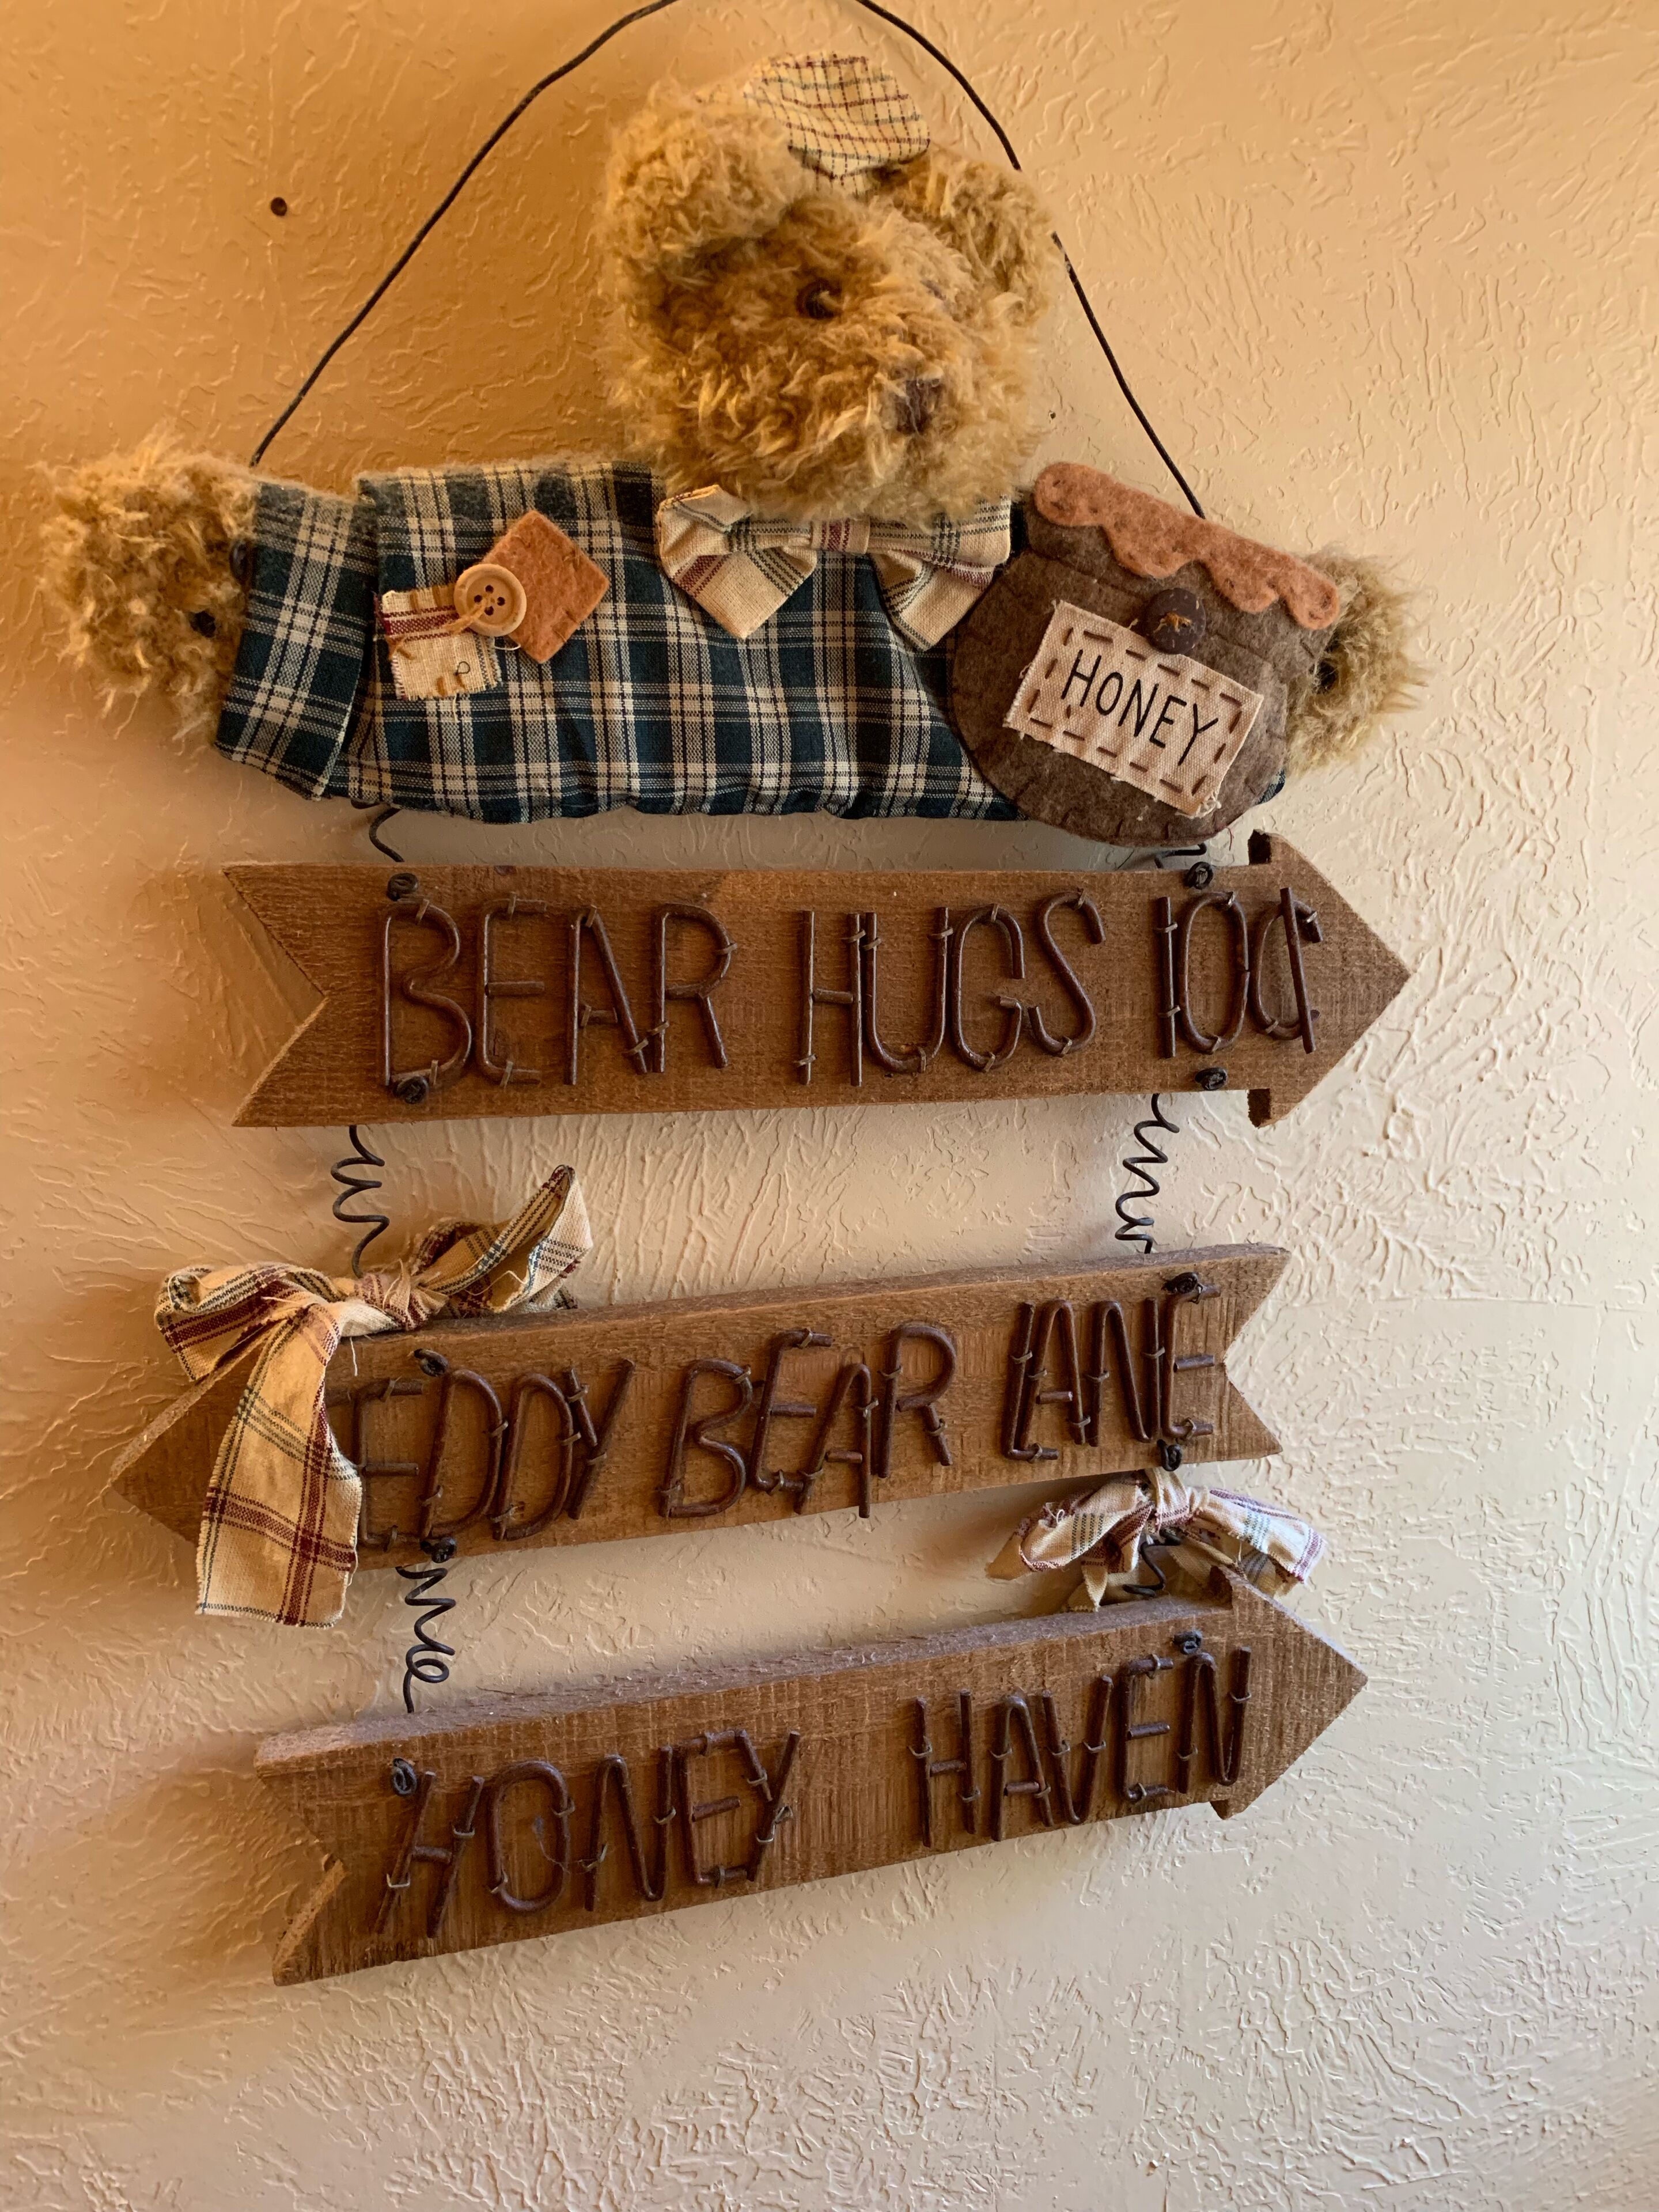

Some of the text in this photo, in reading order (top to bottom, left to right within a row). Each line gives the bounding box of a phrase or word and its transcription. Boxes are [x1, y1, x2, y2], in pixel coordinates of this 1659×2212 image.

[1061, 649, 1219, 766] HONEY
[382, 896, 738, 1086] BEAR
[801, 888, 1106, 1088] HUGS
[327, 1285, 1221, 1541] EDDY BEAR LANE
[374, 1646, 1252, 1938] HONEY HAVEN
